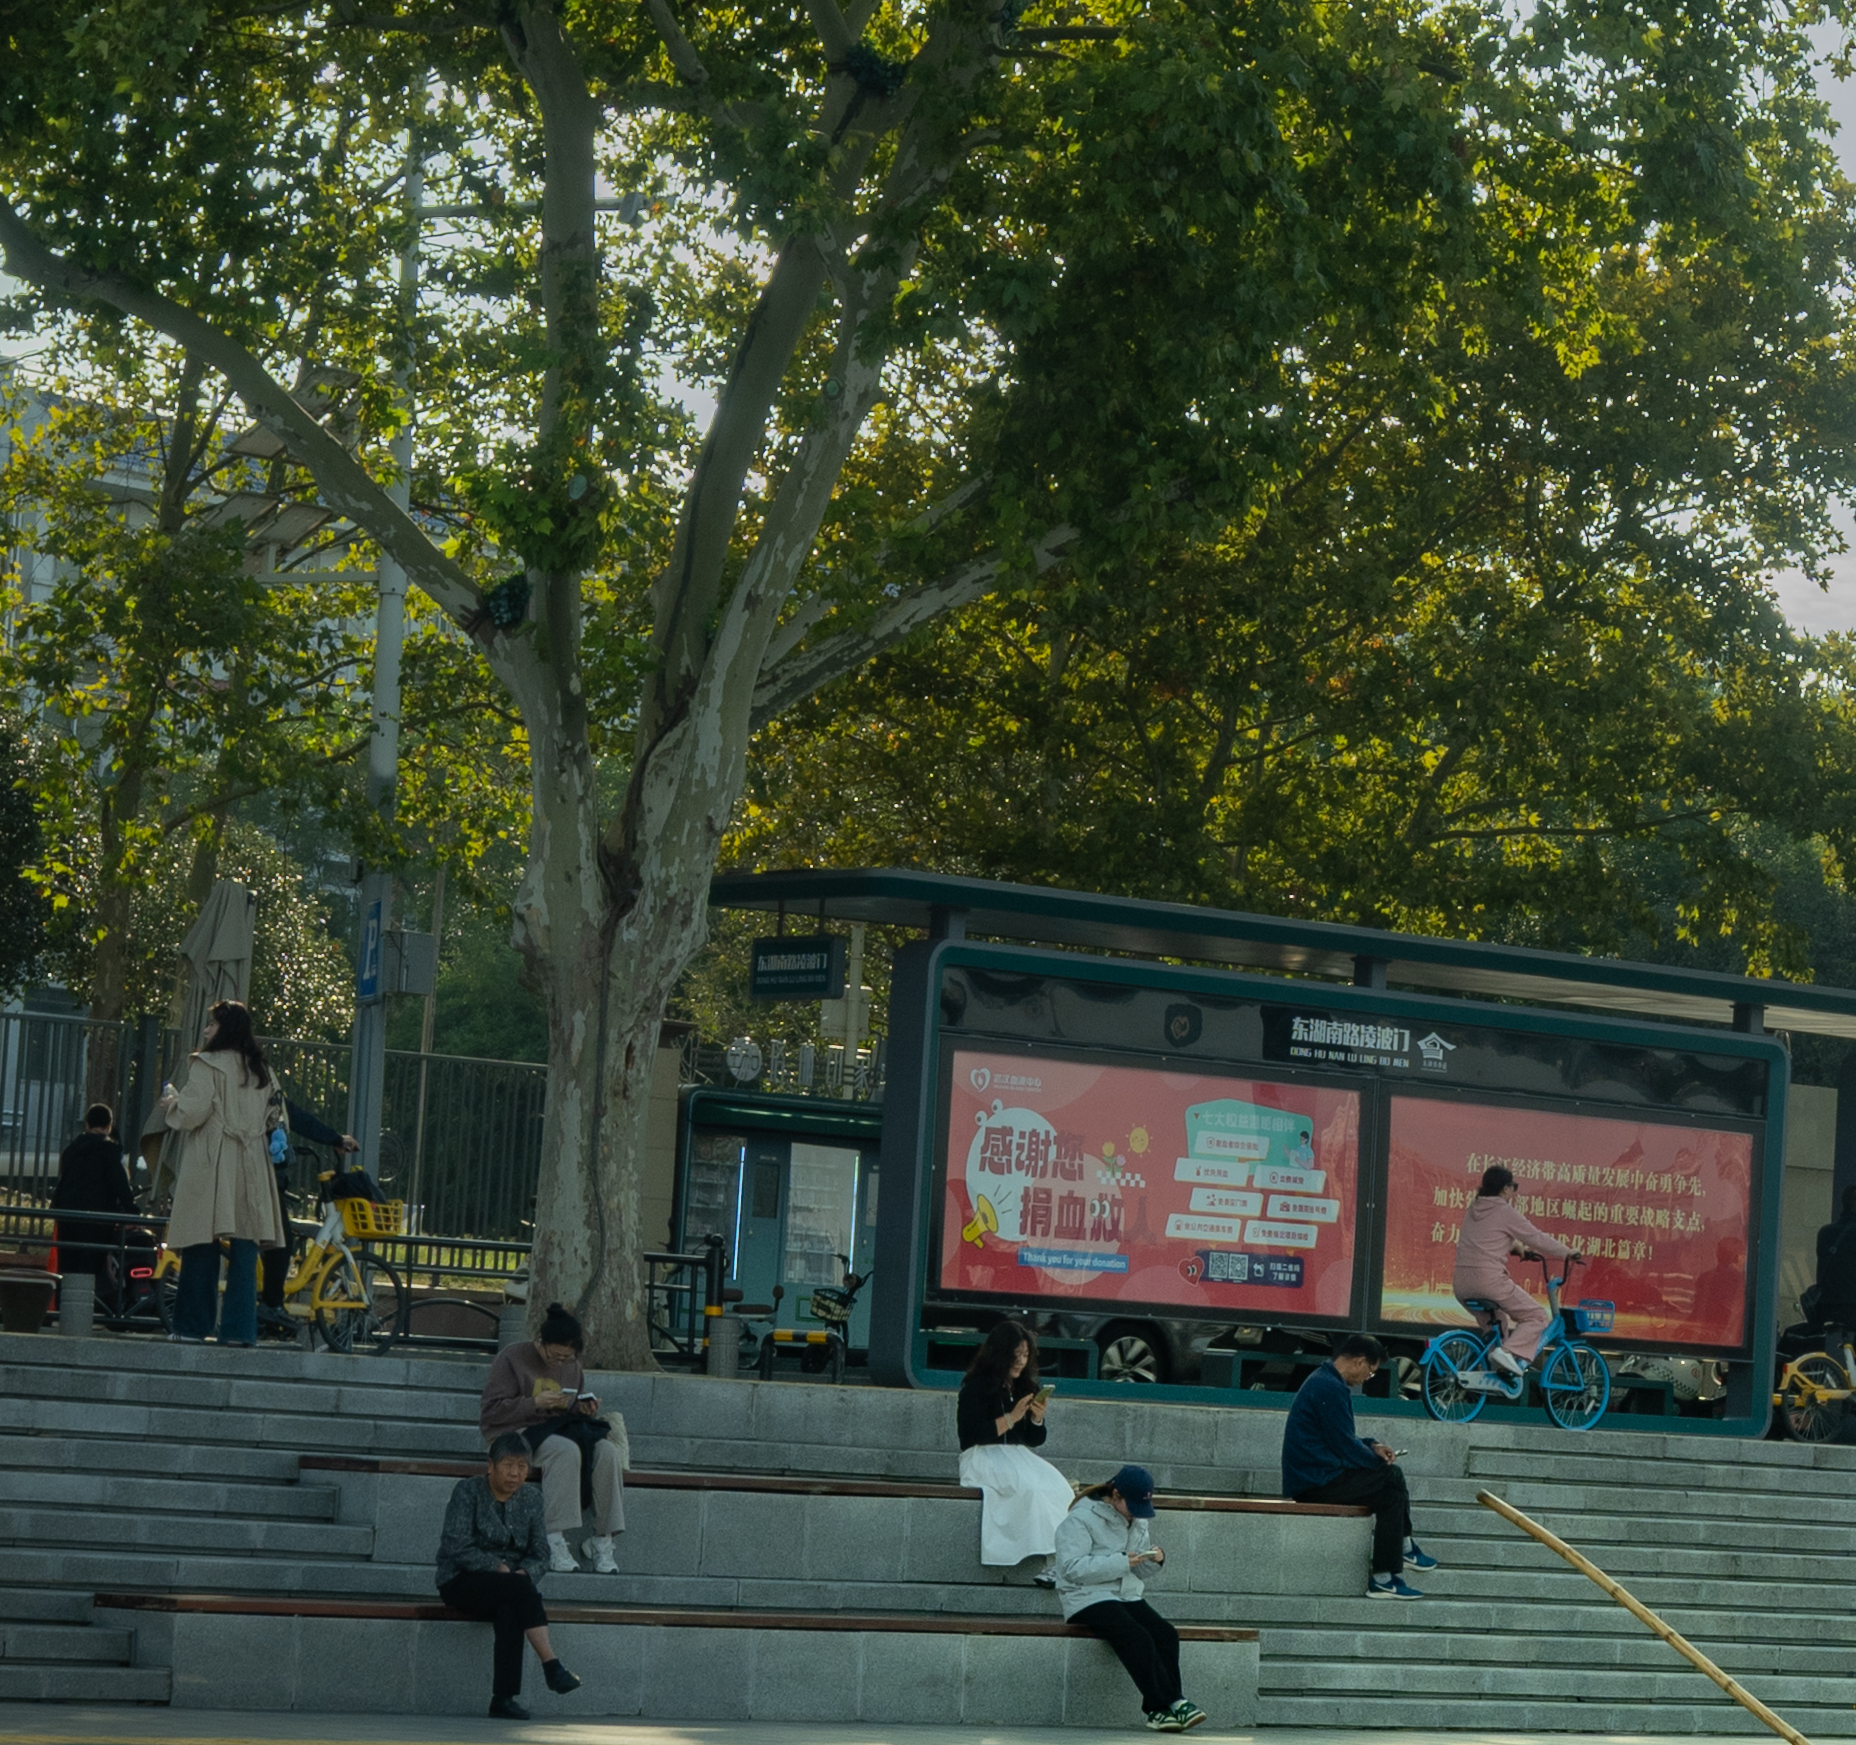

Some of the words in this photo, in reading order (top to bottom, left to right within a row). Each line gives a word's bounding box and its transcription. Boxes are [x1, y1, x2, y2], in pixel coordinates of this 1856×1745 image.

[363, 919, 378, 980] P
[1290, 1046, 1312, 1058] DONG
[1314, 1049, 1327, 1059] HU
[1328, 1050, 1345, 1061] NAN
[1347, 1052, 1358, 1063] LU
[1359, 1053, 1377, 1065] LING
[1379, 1055, 1391, 1066] BO
[1392, 1057, 1410, 1068] MEN
[1291, 1016, 1410, 1052] 东湖南路凌波门
[979, 1125, 1085, 1182] 感谢您
[1019, 1186, 1156, 1245] 捐血救人
[1023, 1252, 1047, 1263] Thank
[1047, 1256, 1062, 1265] you
[1063, 1254, 1073, 1264] for
[1074, 1258, 1091, 1267] your
[1092, 1257, 1126, 1269] donation
